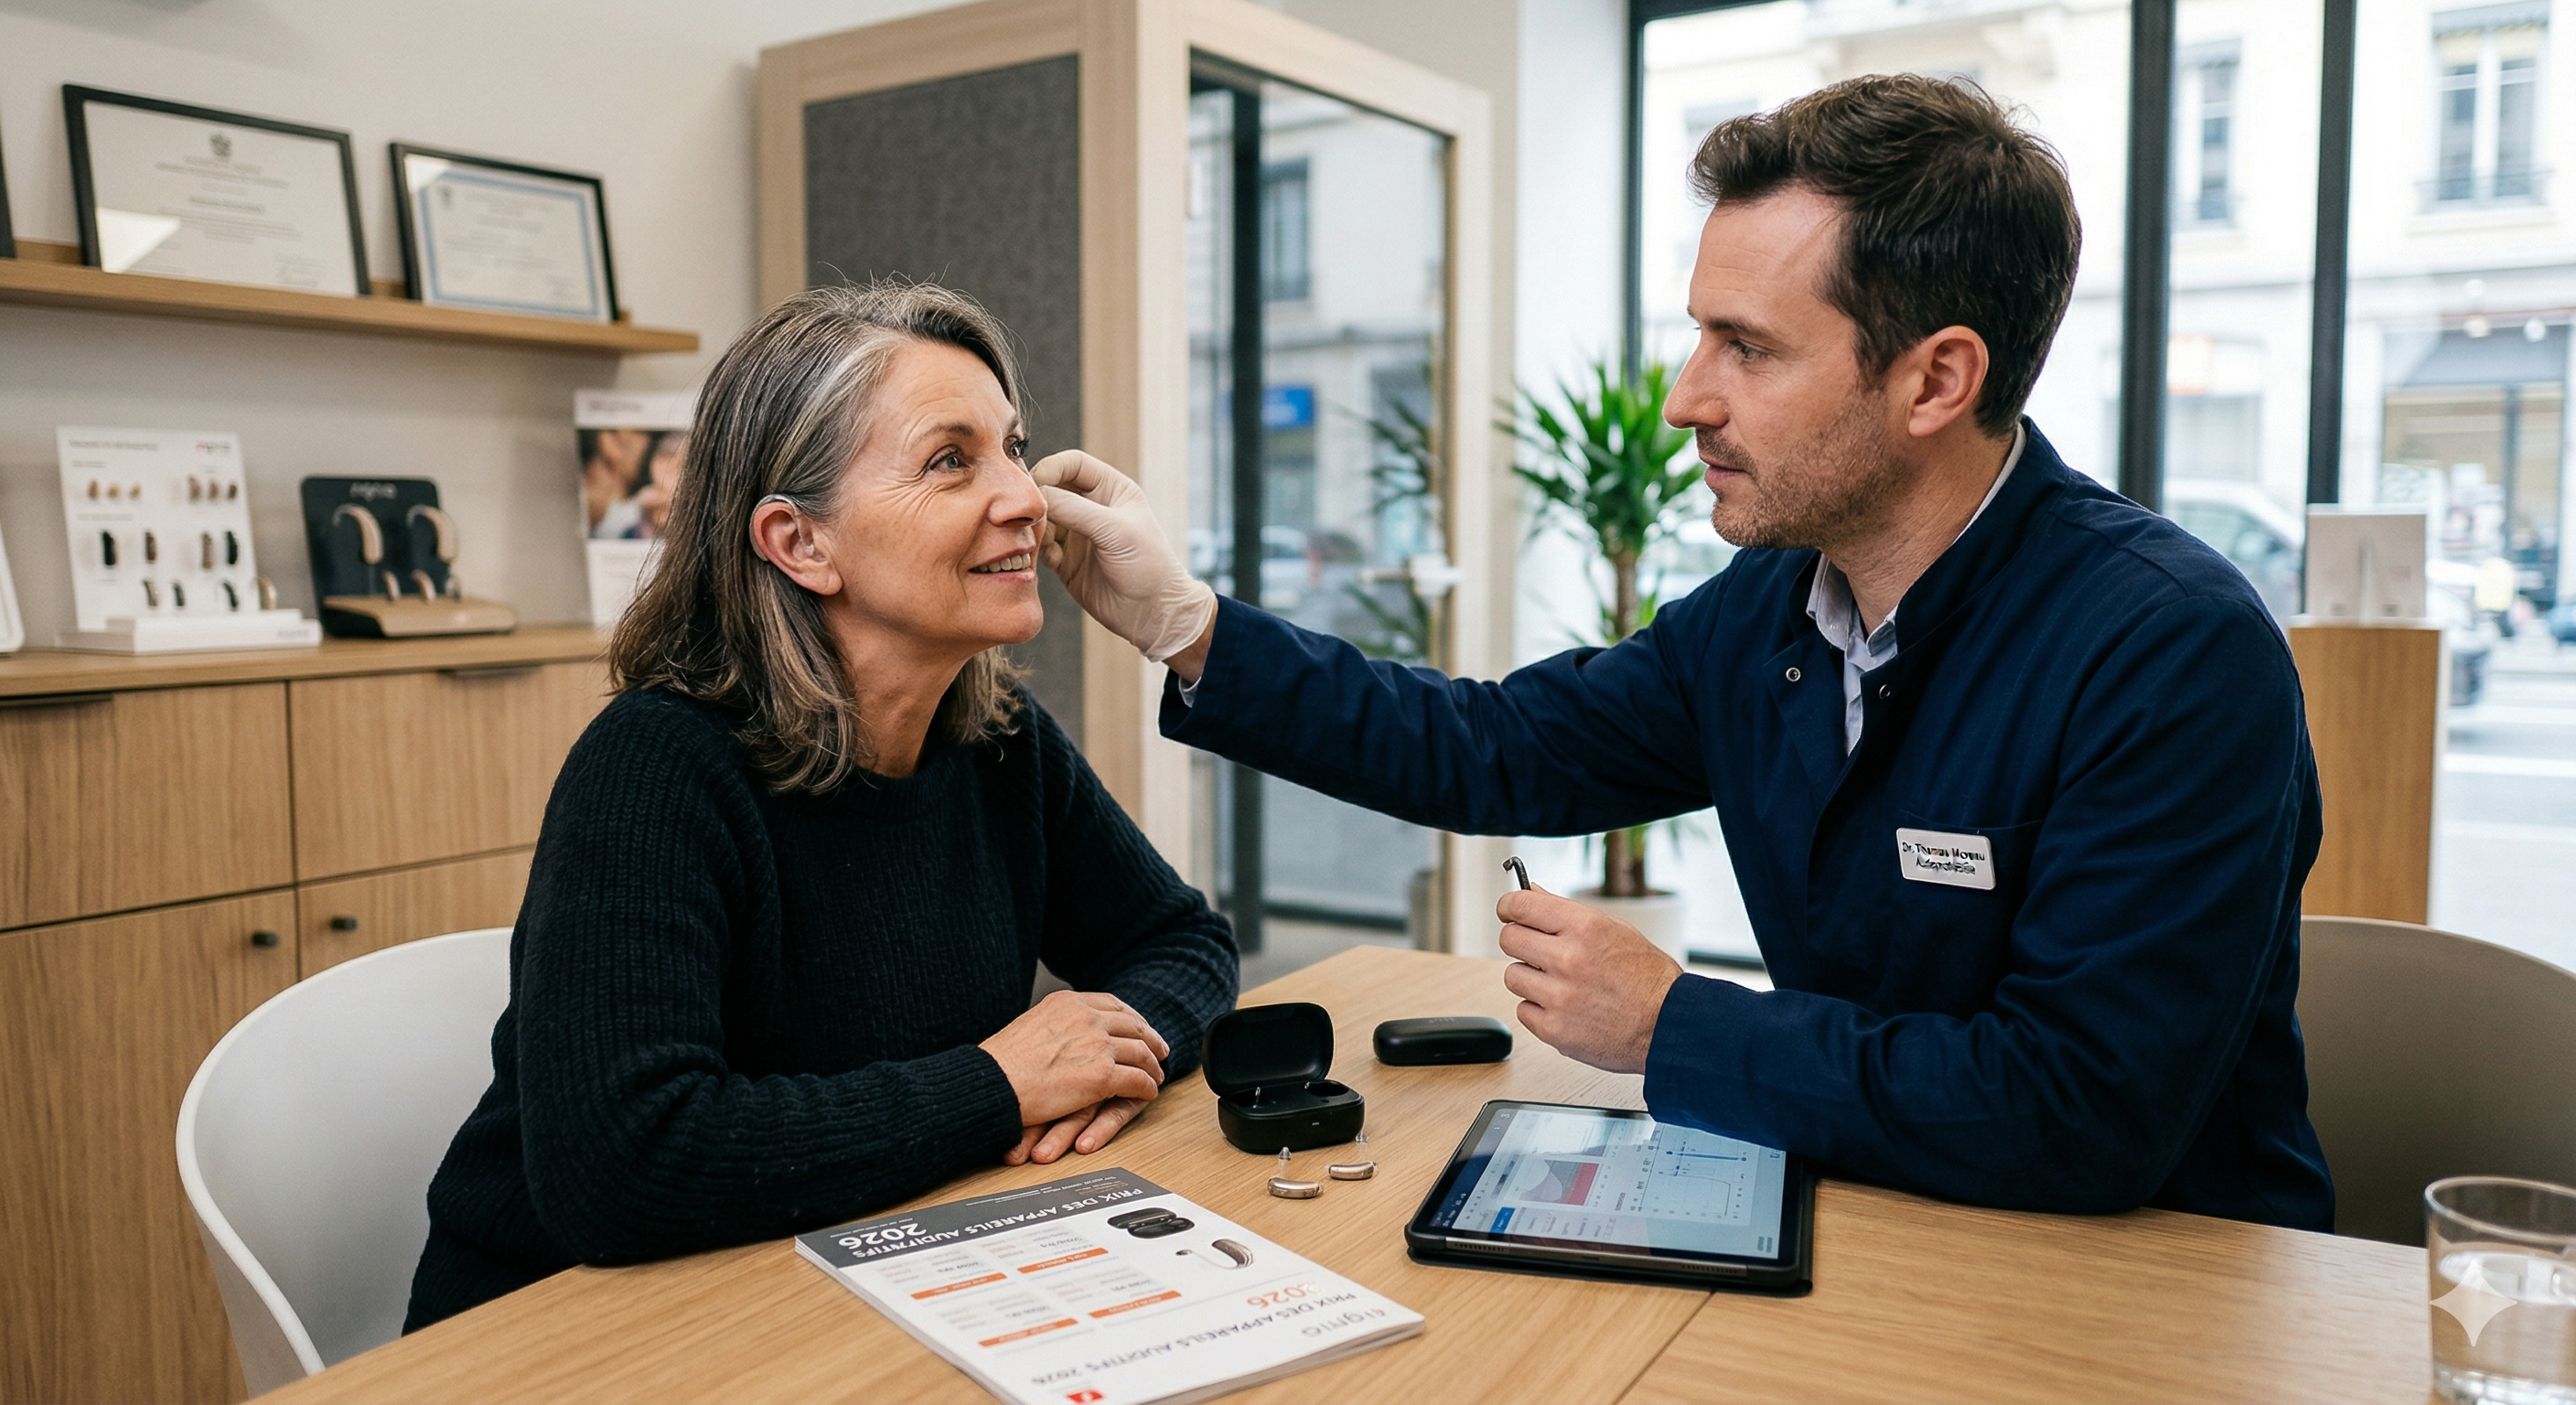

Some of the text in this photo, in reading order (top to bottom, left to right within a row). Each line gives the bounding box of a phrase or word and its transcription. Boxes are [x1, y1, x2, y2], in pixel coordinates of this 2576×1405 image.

[1061, 1197, 1099, 1211] DES
[1104, 1188, 1143, 1204] PRIX
[964, 1206, 1057, 1234] APPAREILS
[838, 1222, 928, 1250] 2026
[1246, 1281, 1323, 1309] 2026
[1315, 1292, 1358, 1308] PRIX
[1276, 1303, 1315, 1319] DES
[1175, 1315, 1273, 1348] APPAREILS
